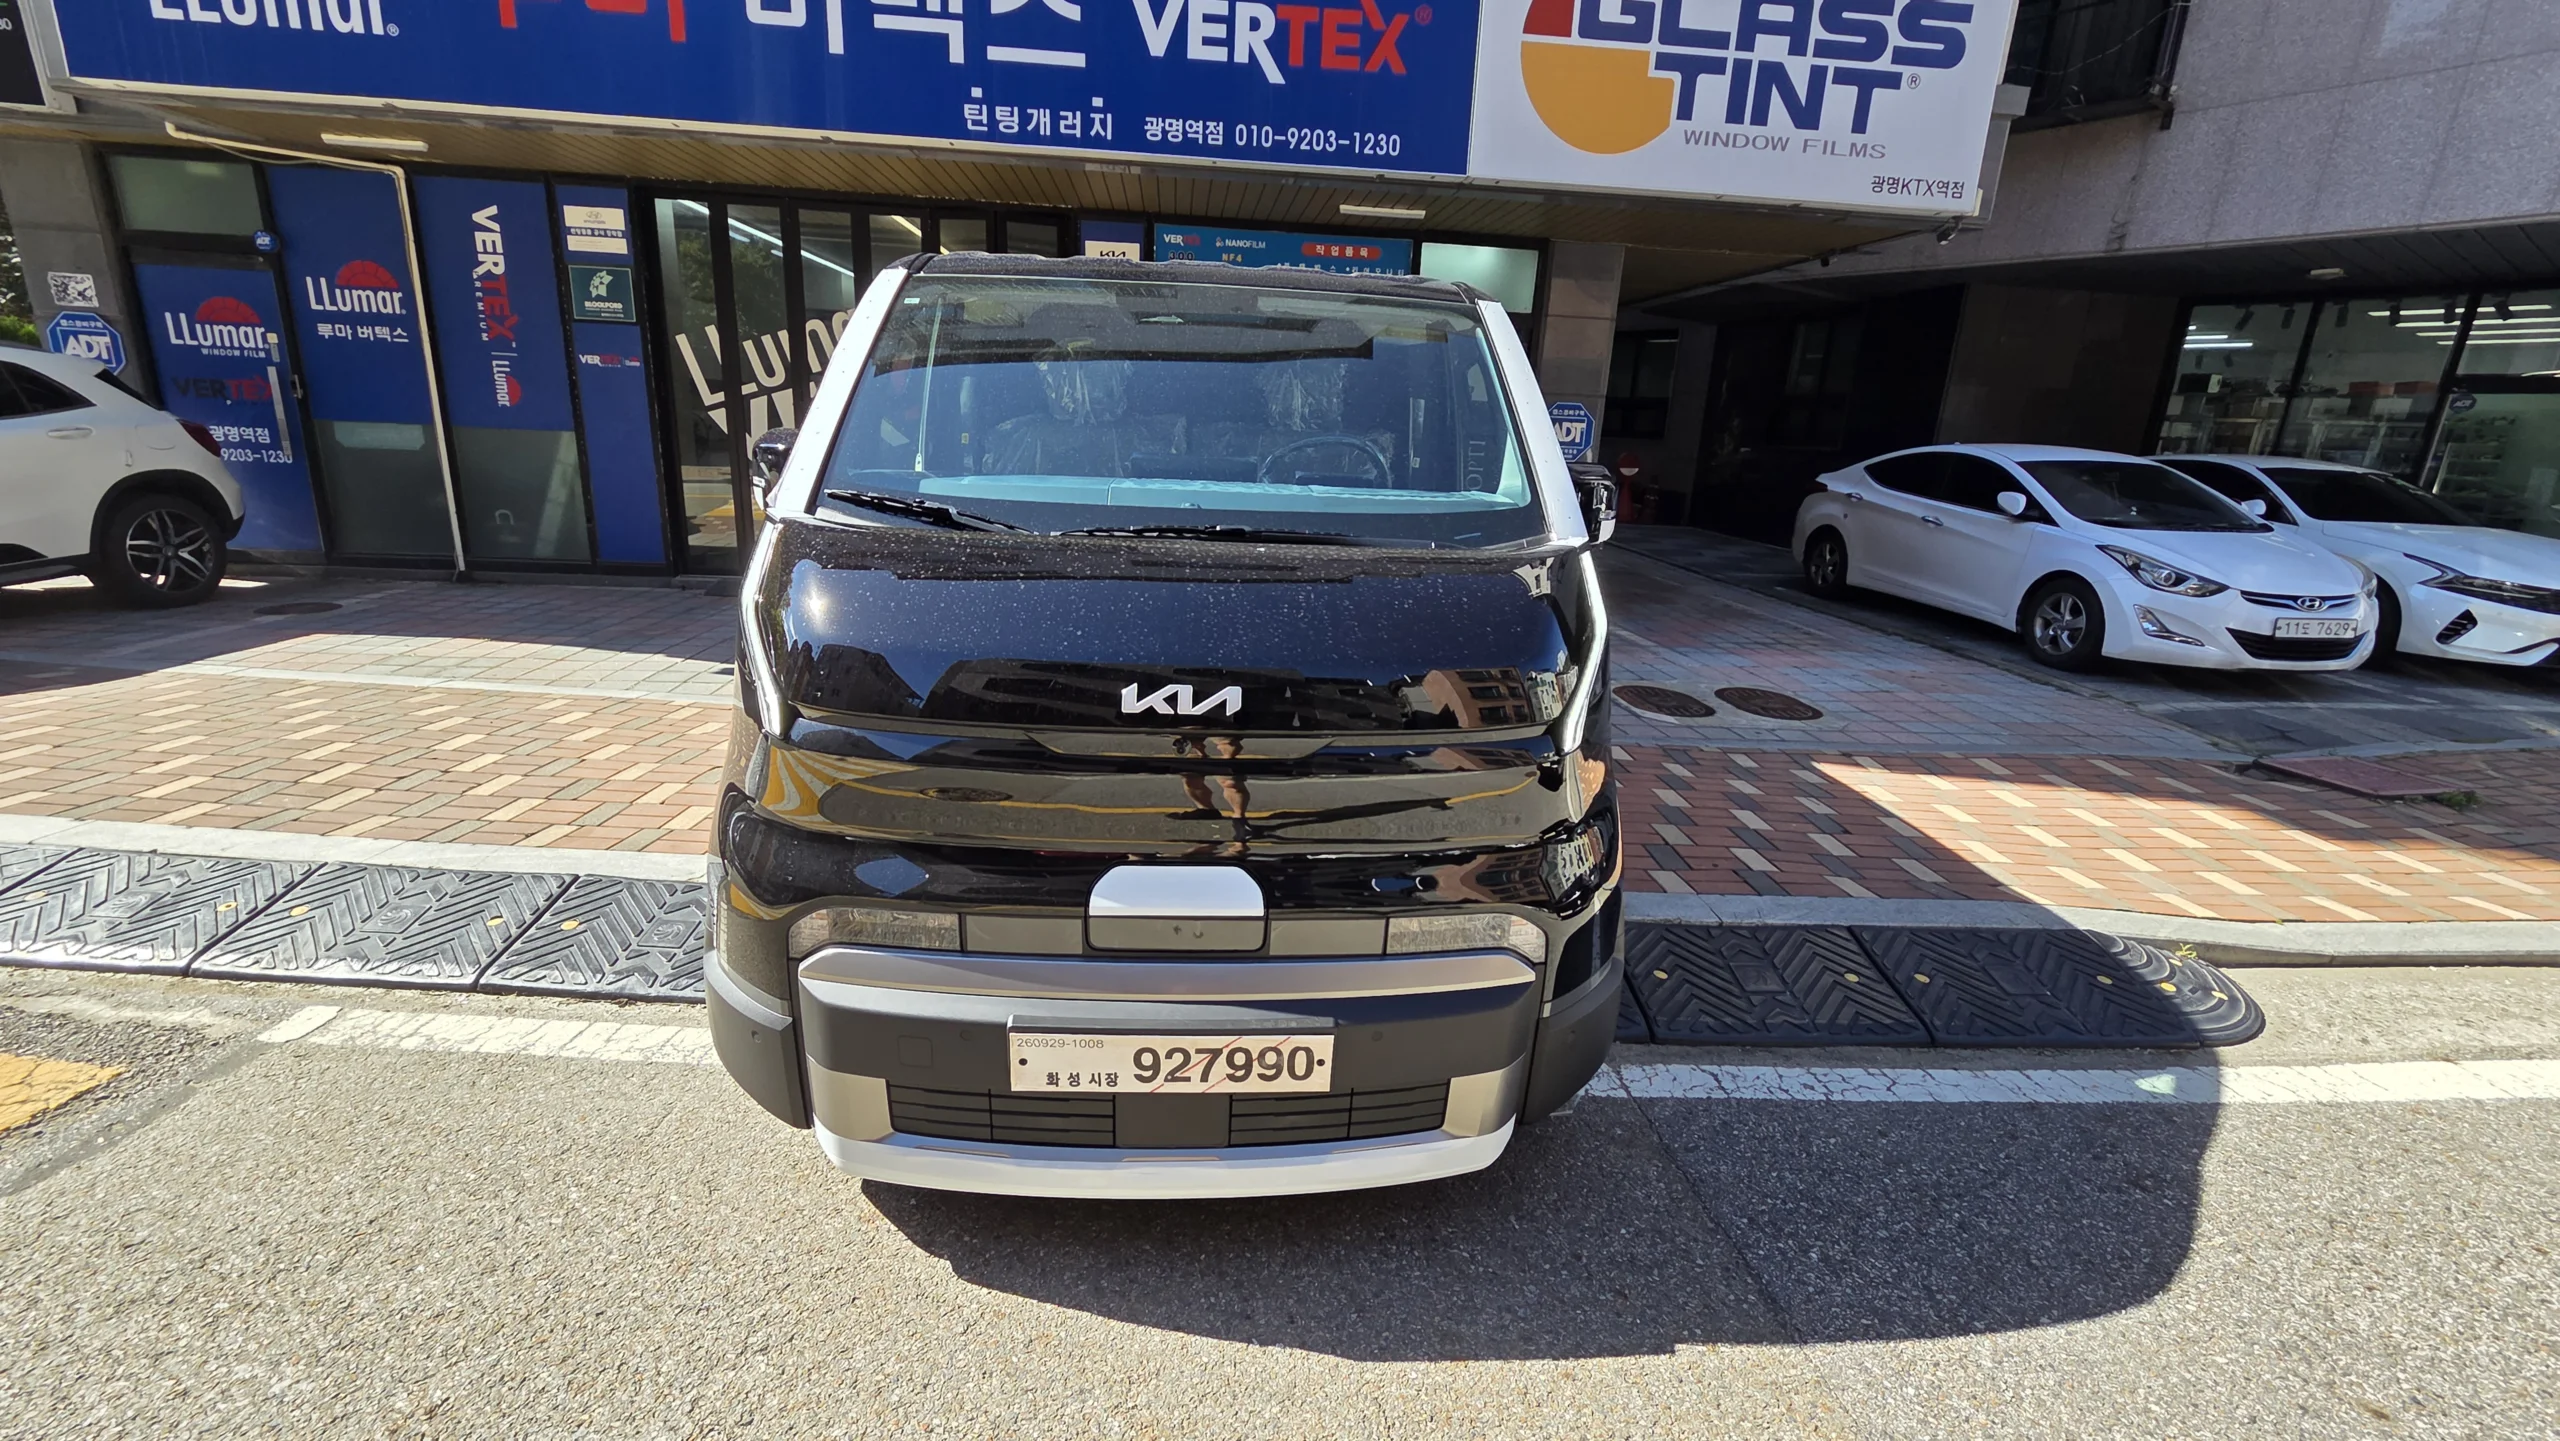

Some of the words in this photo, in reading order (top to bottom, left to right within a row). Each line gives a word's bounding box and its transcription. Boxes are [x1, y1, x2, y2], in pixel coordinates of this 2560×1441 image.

[151, 0, 385, 36] umar
[1132, 0, 1410, 85] VERTEX
[1577, 0, 1975, 69] GLASS
[1654, 51, 1904, 135] TINT
[963, 87, 1113, 140] 틴팅개러지
[1143, 115, 1224, 146] 광명역점
[1234, 123, 1402, 157] 010-9203-1230
[1684, 129, 1791, 152] WINDOW
[1801, 138, 1887, 160] FILMS
[1870, 175, 1966, 199] 광명KTX역점
[1168, 251, 1195, 262] 300
[1225, 239, 1266, 249] NANOFILM
[472, 204, 519, 340] VERTEX
[306, 275, 404, 315] LLumar
[164, 311, 265, 350] LLumar
[316, 323, 353, 341] 루마
[356, 324, 410, 343] 버텍스
[65, 334, 111, 360] ADT
[200, 348, 241, 358] WINDOW
[243, 350, 266, 359] FILM
[208, 425, 271, 444] 광명역점
[1554, 421, 1586, 443] ADT
[2285, 621, 2310, 635] 11도
[2316, 622, 2351, 636] 7629
[1121, 682, 1242, 716] KIA
[1016, 1037, 1105, 1050] 260929-1008
[1132, 1046, 1315, 1084] 927990
